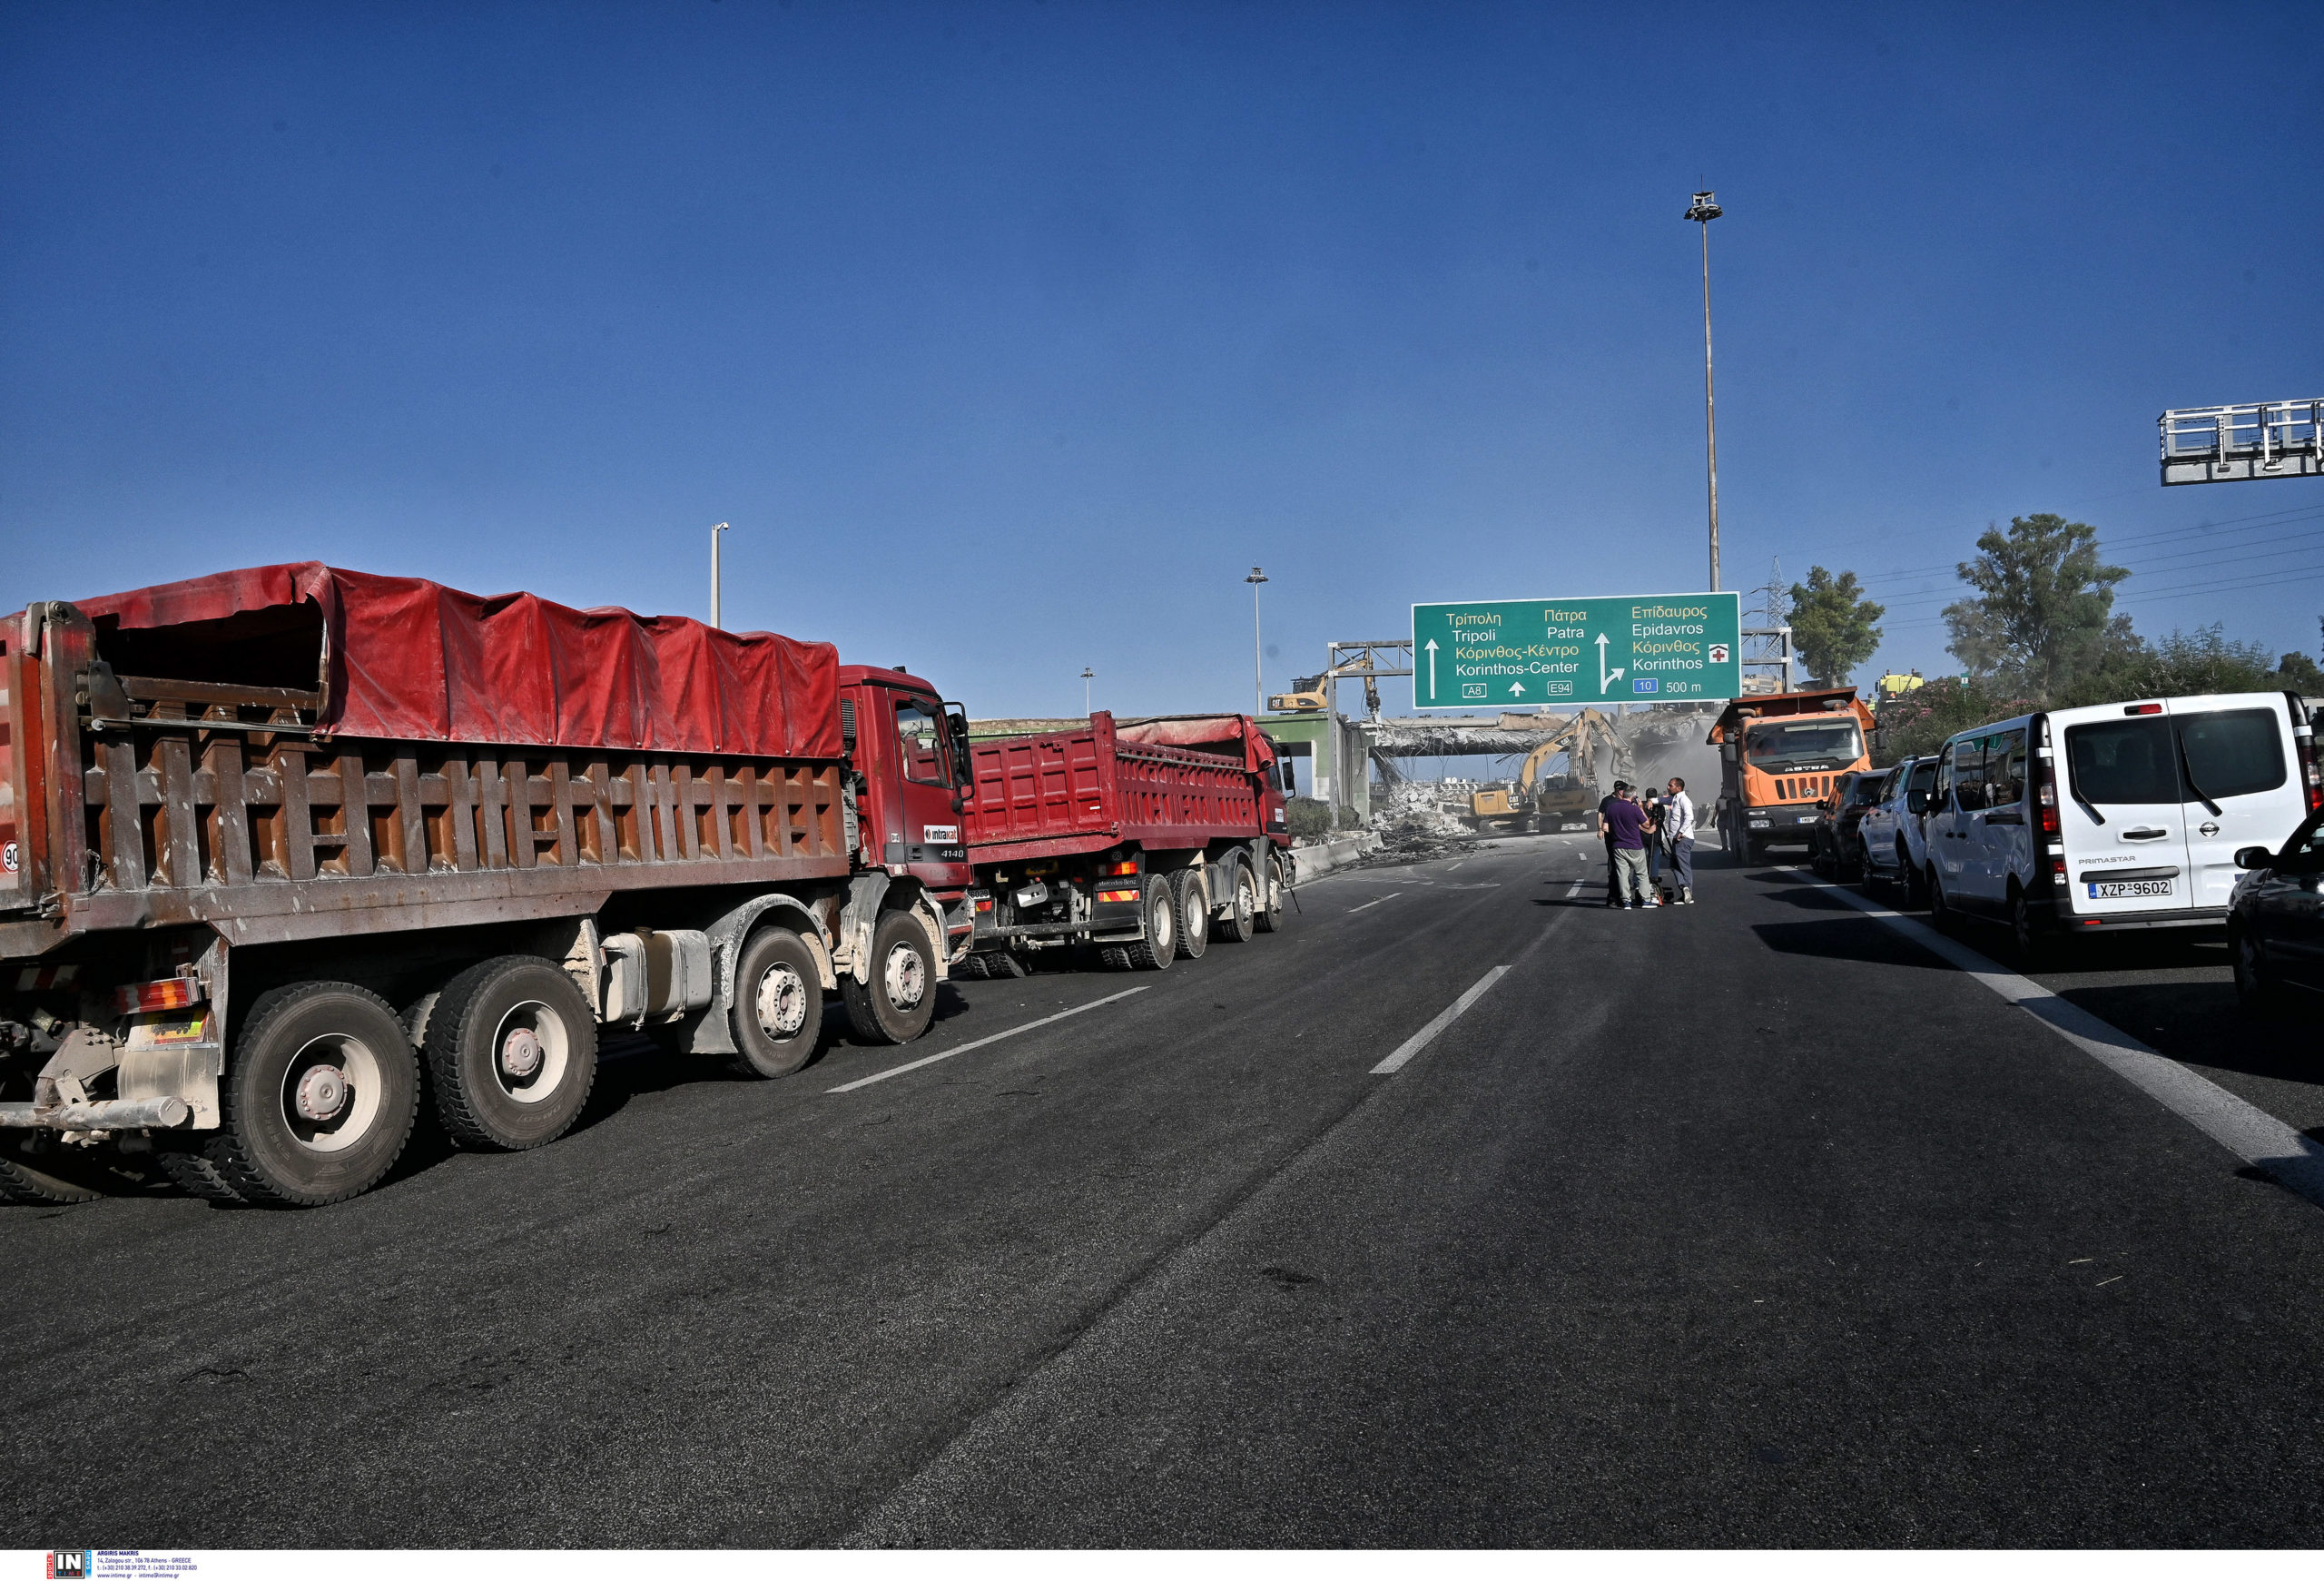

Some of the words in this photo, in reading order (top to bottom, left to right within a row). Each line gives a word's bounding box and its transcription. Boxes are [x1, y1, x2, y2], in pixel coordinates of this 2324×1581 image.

[1446, 612, 1502, 627] Τρίπολη
[1544, 609, 1587, 624] Πάτρα
[1631, 605, 1708, 620] Επίδαυρος
[1452, 628, 1496, 645] Tripoli
[1547, 627, 1584, 639] Patra
[1632, 623, 1704, 638] Epidavros
[1455, 644, 1580, 661] Κόρινθος-Κέντρο
[1632, 639, 1700, 656] Κόρινθος
[1456, 661, 1580, 677] Korinthos-Center
[1633, 657, 1703, 671] Korinthos
[1467, 686, 1482, 696] A8
[1550, 683, 1571, 693] E94
[1639, 681, 1652, 691] 10
[1666, 682, 1687, 692] 500
[1691, 684, 1701, 692] m
[931, 828, 957, 840] intrakat
[5, 847, 18, 865] 90
[940, 849, 964, 858] 4140
[2078, 855, 2136, 865] PRIMASTAR
